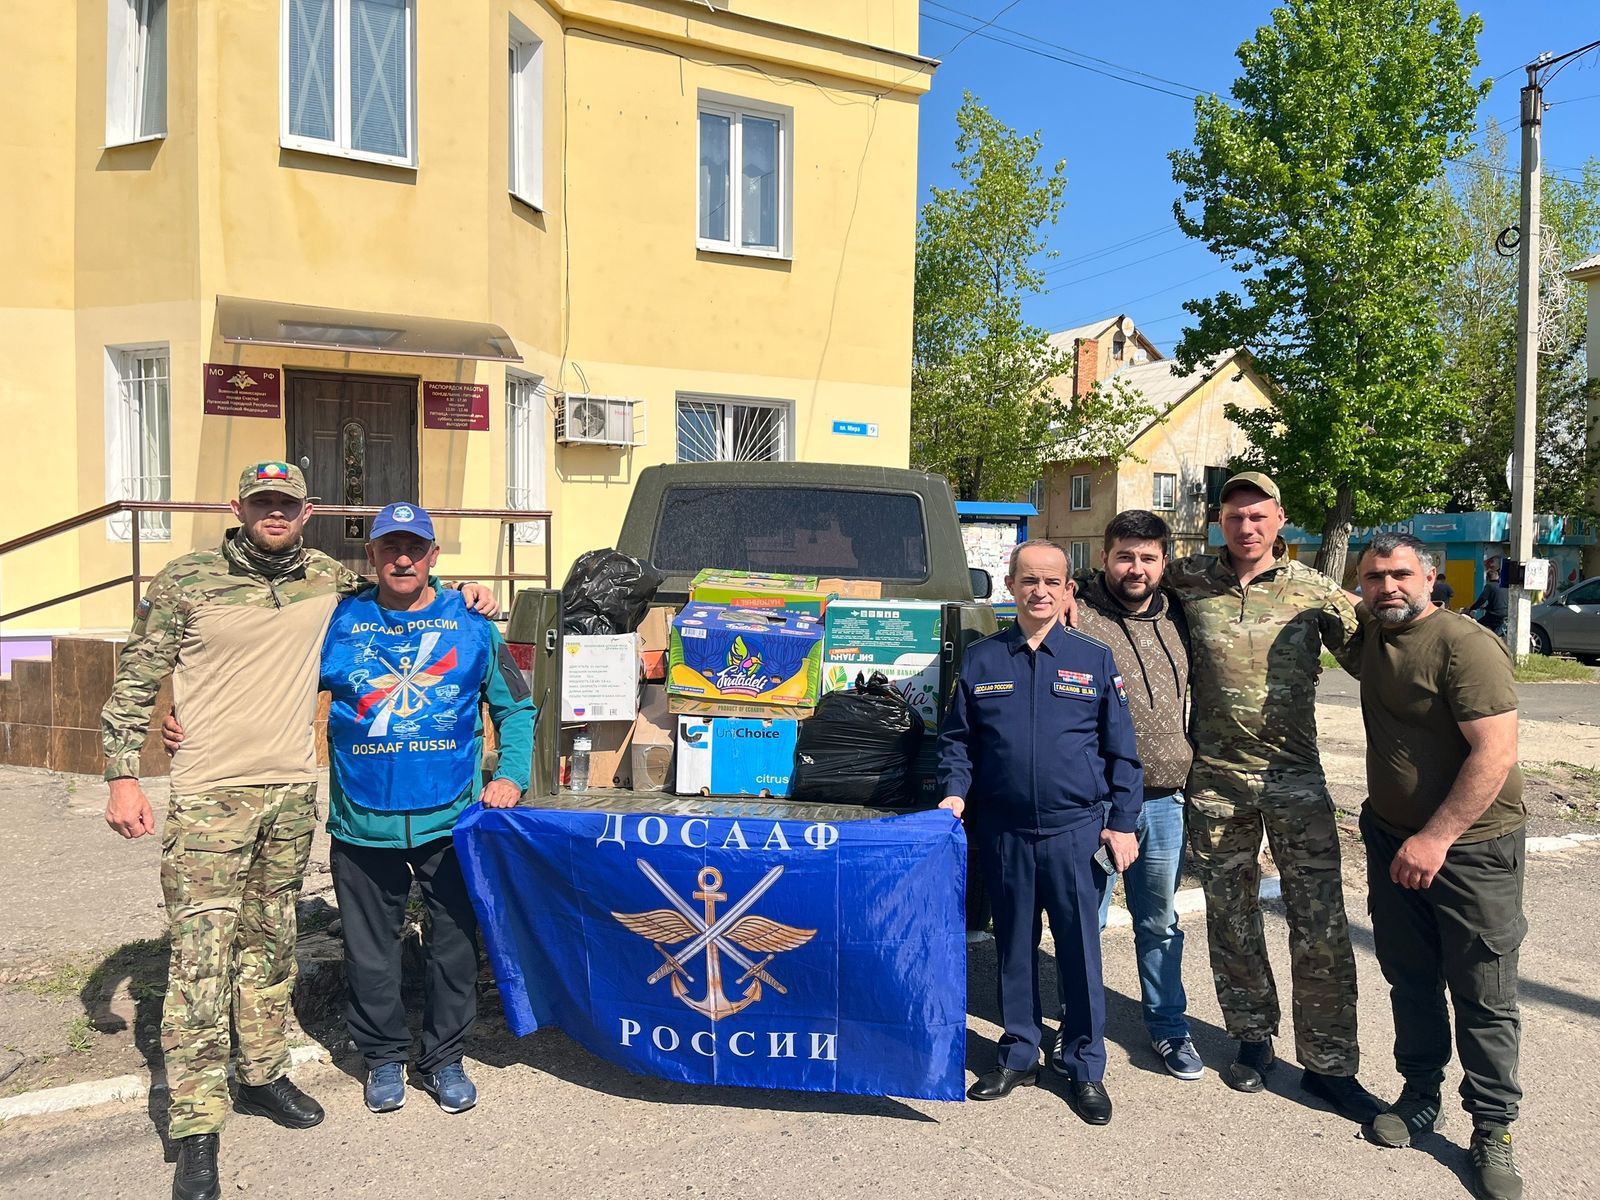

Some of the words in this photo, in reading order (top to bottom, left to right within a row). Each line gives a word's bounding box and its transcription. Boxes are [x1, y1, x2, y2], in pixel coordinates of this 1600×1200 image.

[209, 368, 224, 376] МО
[263, 372, 275, 380] РФ
[351, 622, 404, 637] ДОСААФ
[408, 618, 458, 633] РОССИИ
[830, 653, 856, 661] ЛАНЧ
[856, 653, 874, 662] БИГ
[716, 666, 768, 690] Frutadeli
[867, 668, 895, 676] PRMIUM
[716, 728, 780, 739] UniChoice
[352, 741, 403, 755] DOSAAF
[408, 739, 457, 753] RUSSIA
[755, 774, 789, 784] citrus
[596, 813, 839, 851] ДОСААФ
[618, 1017, 838, 1061] РОССИИ
